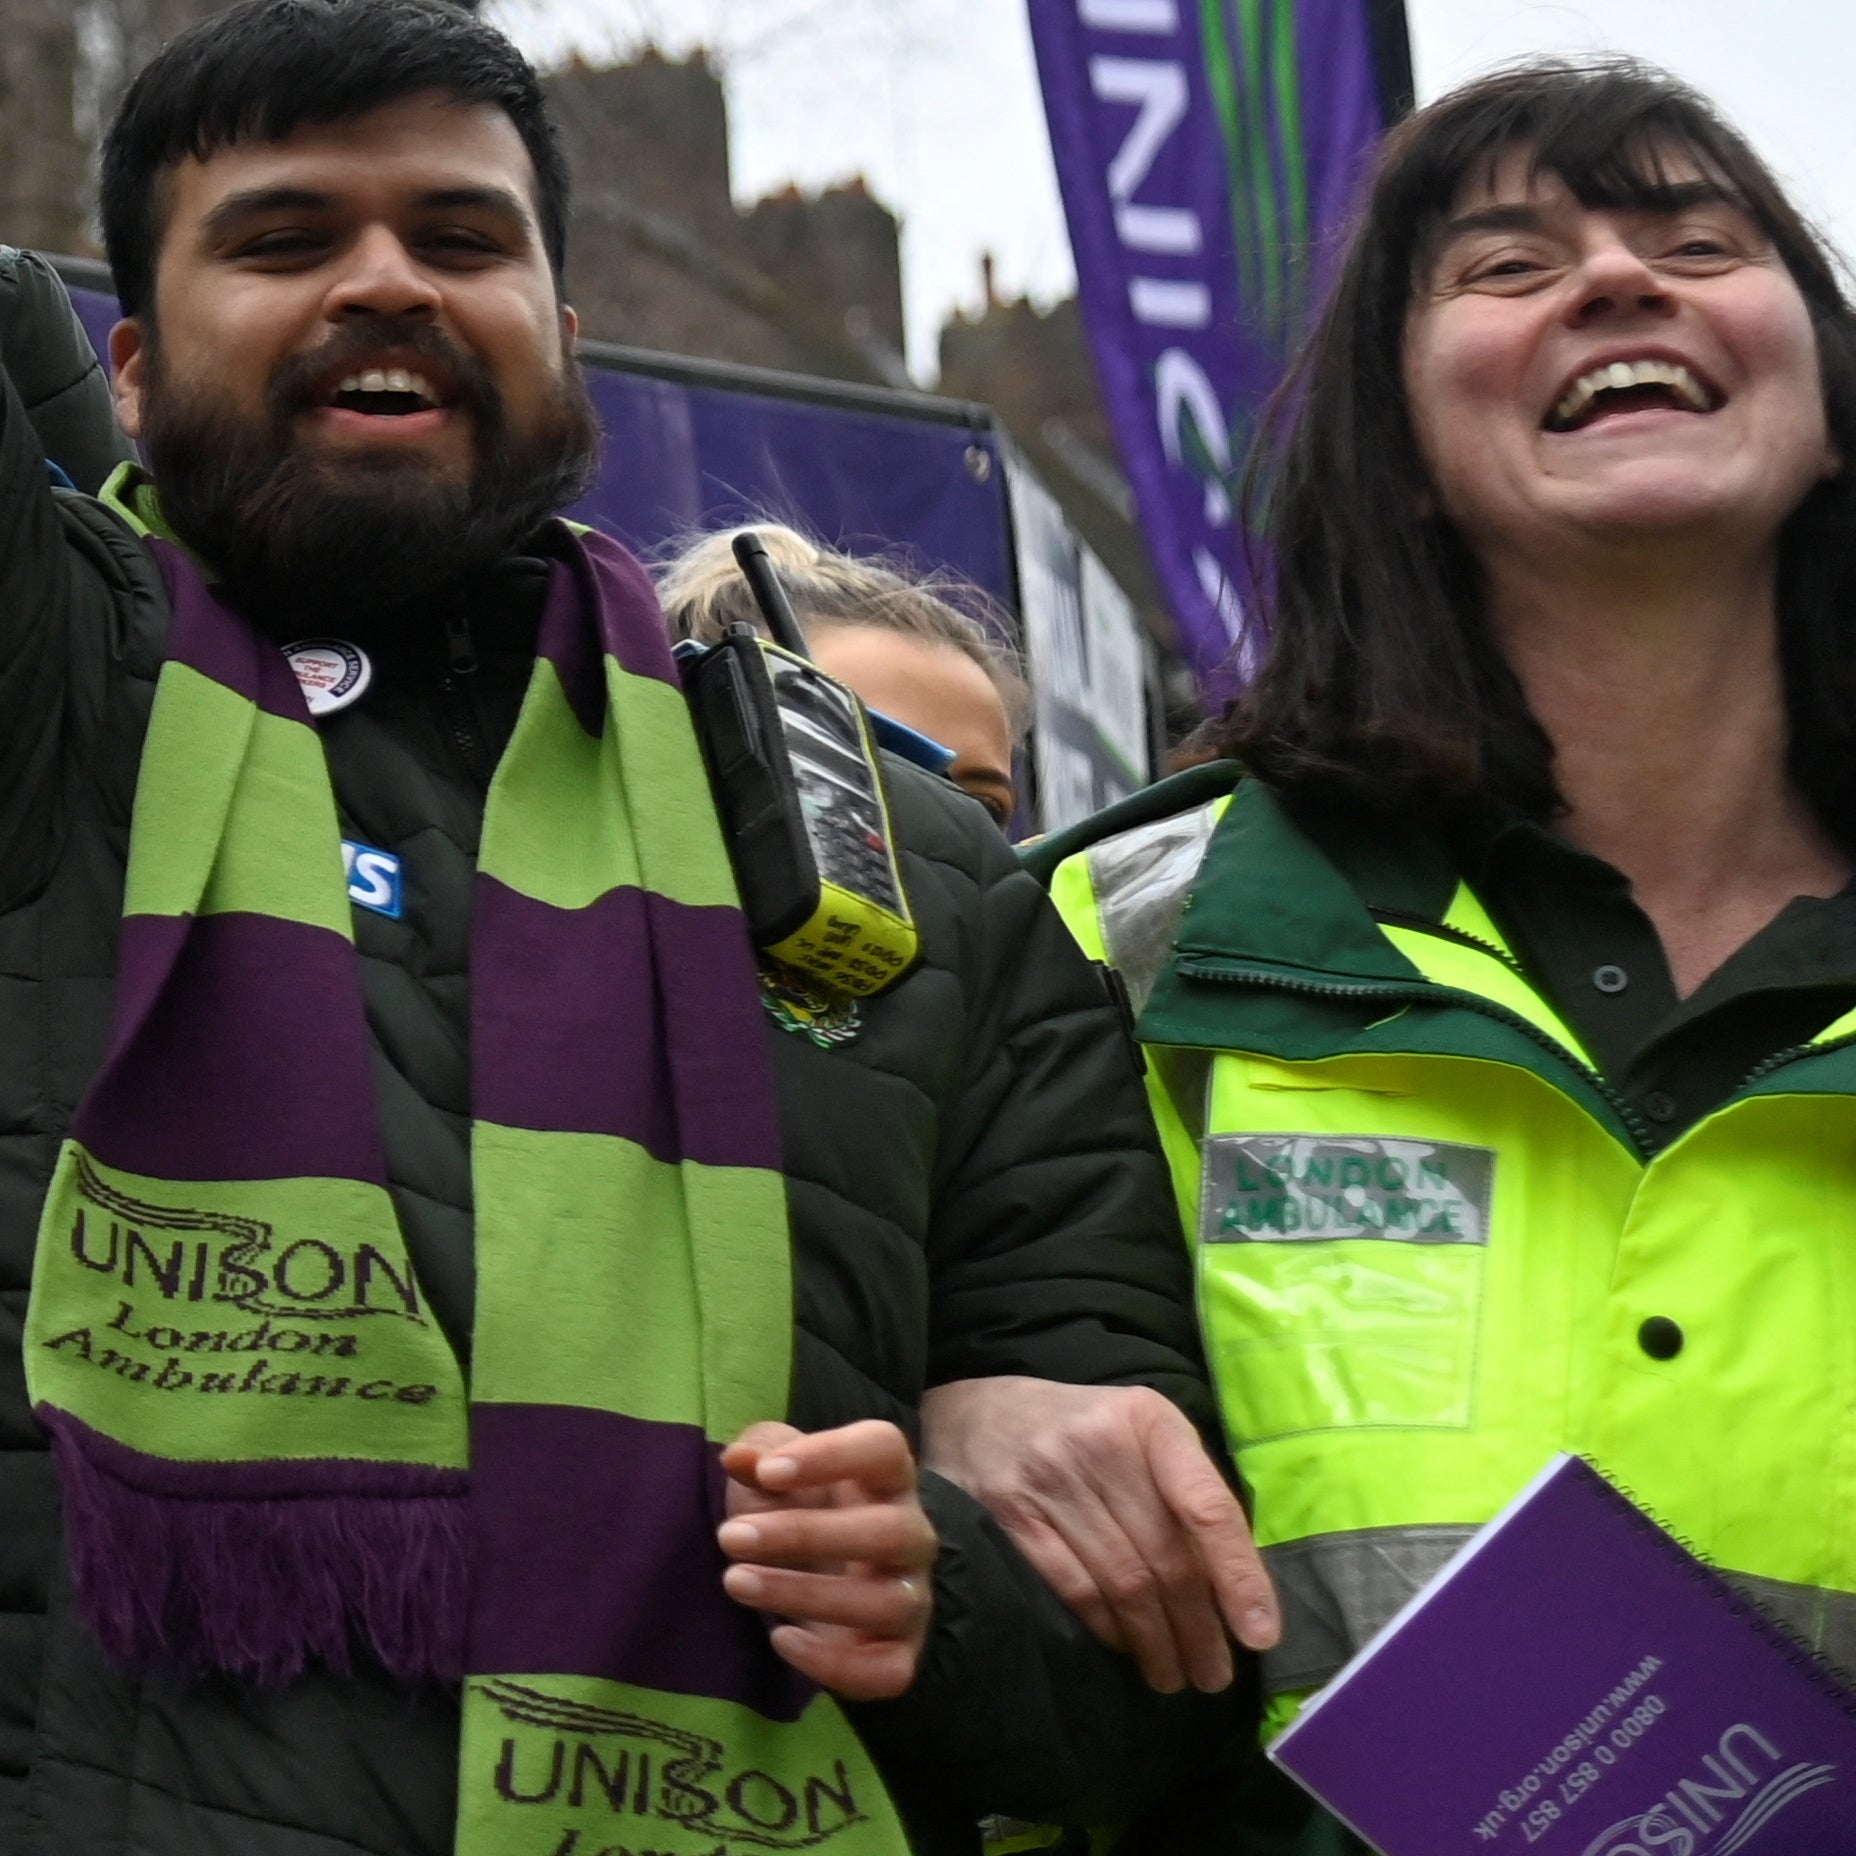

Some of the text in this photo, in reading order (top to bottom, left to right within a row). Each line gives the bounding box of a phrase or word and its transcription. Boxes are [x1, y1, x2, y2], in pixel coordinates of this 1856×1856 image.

[1222, 1197, 1464, 1235] AMBULANCE
[1236, 1152, 1448, 1191] LONDON
[70, 1208, 420, 1314] UNISON
[40, 1328, 437, 1403] Ambulance
[107, 1300, 359, 1357] London
[494, 1739, 859, 1834] UNISON
[1472, 1654, 1664, 1841] www.unison.org.uk
[1521, 1695, 1666, 1843] 0800 0 857 857
[1605, 1723, 1781, 1856] UNIS
